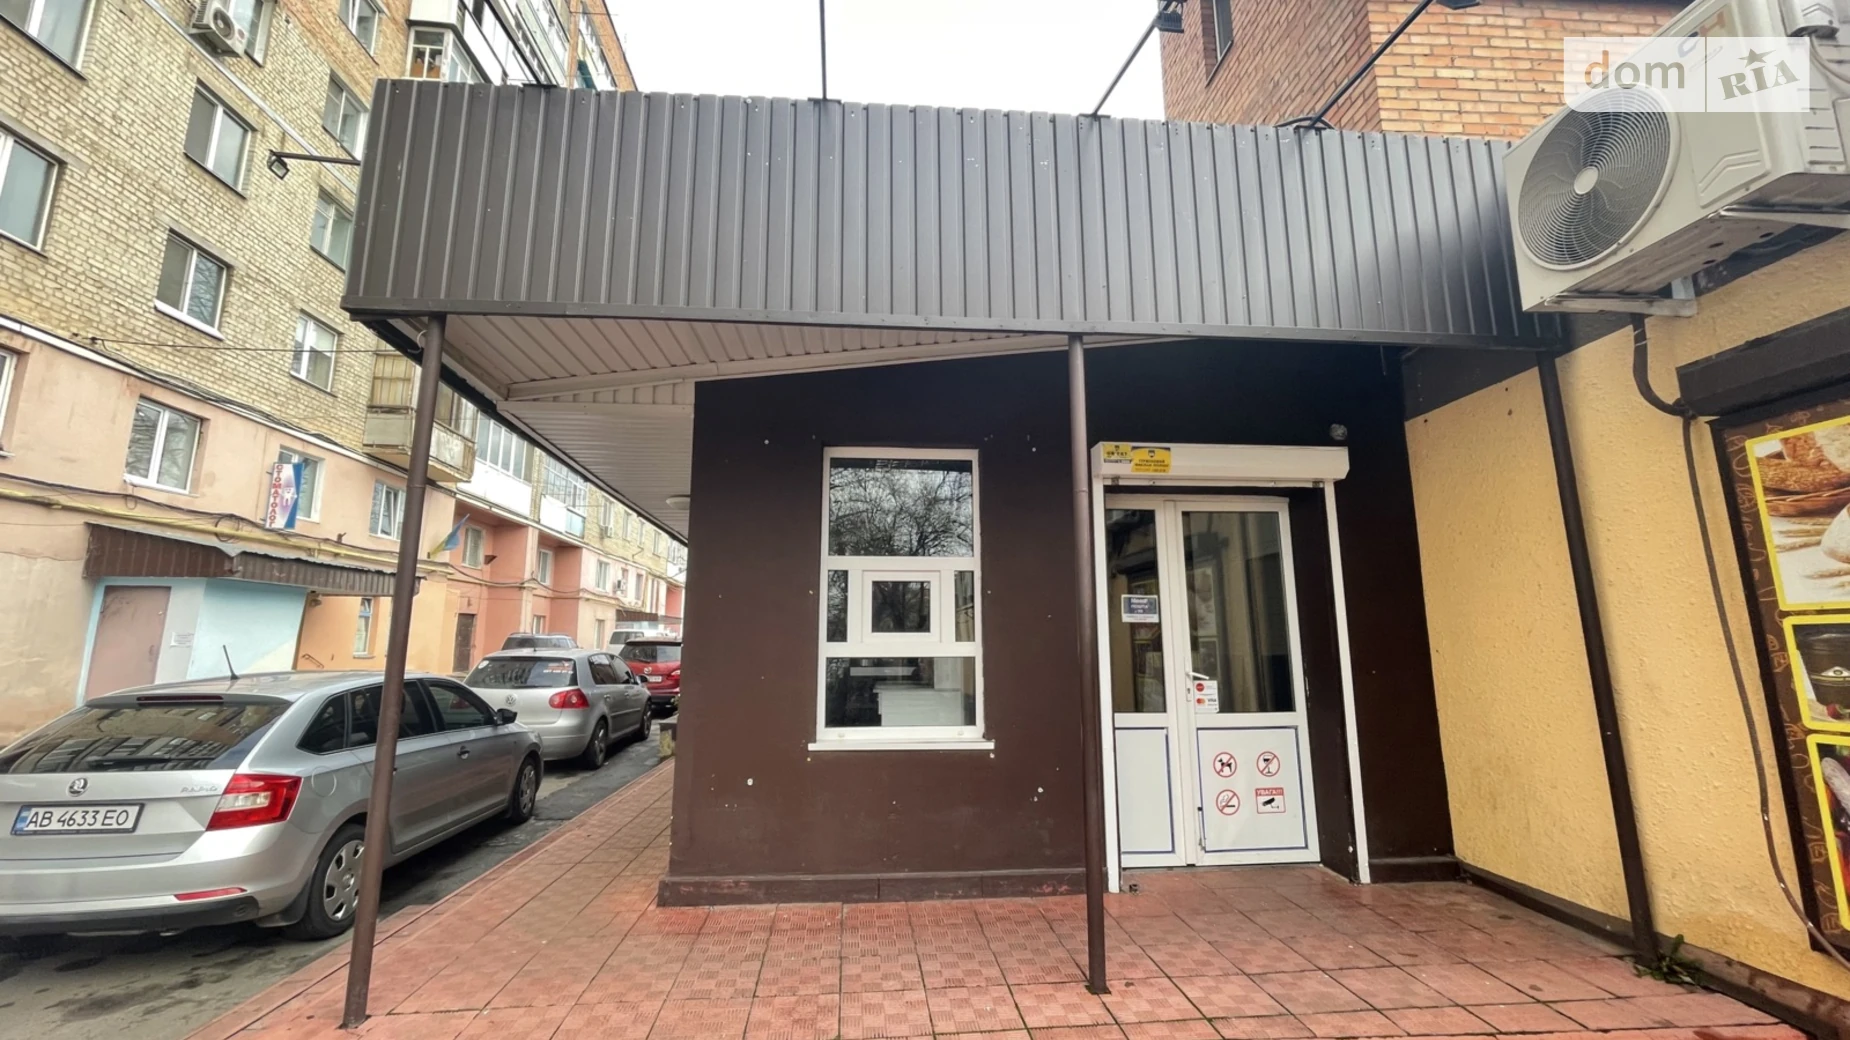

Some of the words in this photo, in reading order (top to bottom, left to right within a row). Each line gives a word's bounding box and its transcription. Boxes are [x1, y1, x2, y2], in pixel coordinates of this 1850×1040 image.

[268, 464, 283, 528] СТОМАТОЛОГ
[26, 810, 53, 828] AB
[57, 810, 100, 828] 4633
[101, 809, 129, 827] EO
